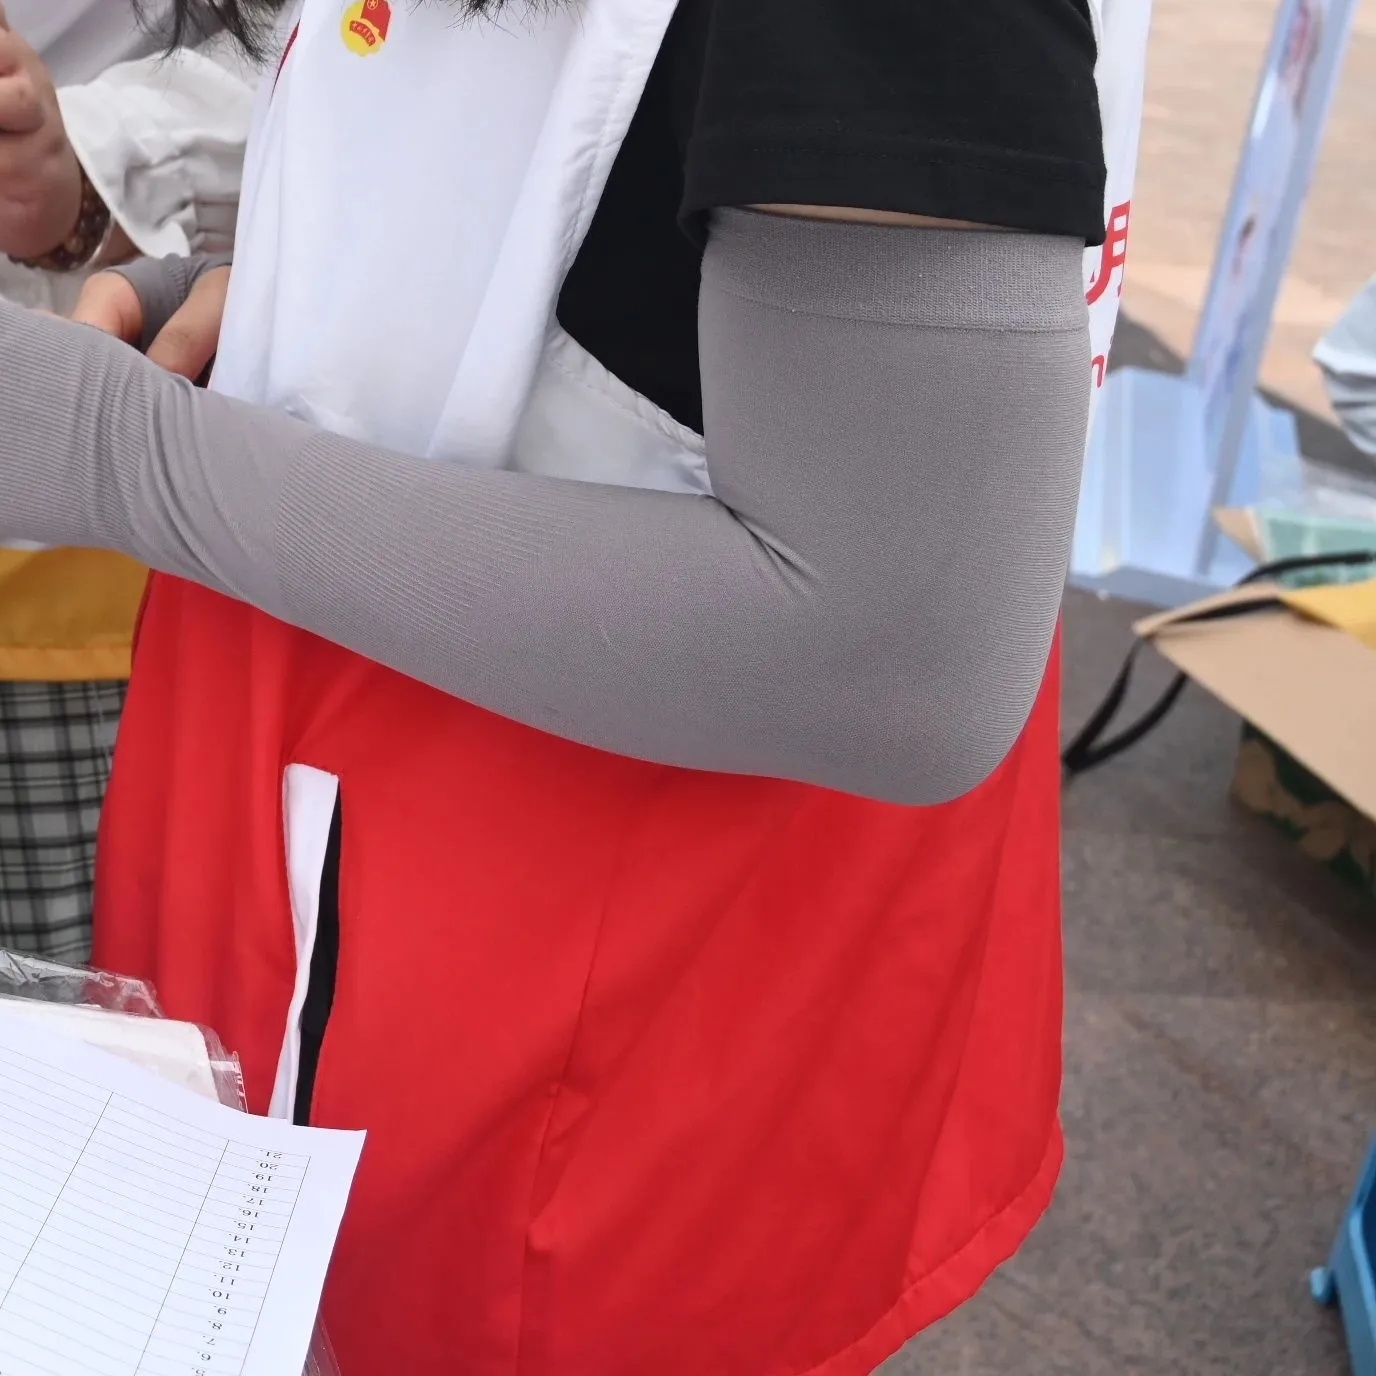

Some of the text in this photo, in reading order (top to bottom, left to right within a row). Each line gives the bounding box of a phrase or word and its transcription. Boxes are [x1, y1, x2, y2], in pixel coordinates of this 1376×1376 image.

[260, 1149, 282, 1159] 21.
[256, 1160, 279, 1170] 20.
[251, 1172, 272, 1182] 19.
[247, 1183, 268, 1194] 18.
[242, 1195, 264, 1205] 17.
[238, 1208, 259, 1218] 16.
[233, 1220, 254, 1231] 15.
[228, 1233, 249, 1244] 14.
[223, 1246, 245, 1258] 13.
[218, 1260, 240, 1271] 12.
[213, 1274, 235, 1286] 11.
[208, 1288, 230, 1300] 10.
[213, 1305, 227, 1316] 9.
[208, 1320, 223, 1330] 8.
[202, 1335, 216, 1346] 7.
[196, 1351, 211, 1361] 6.
